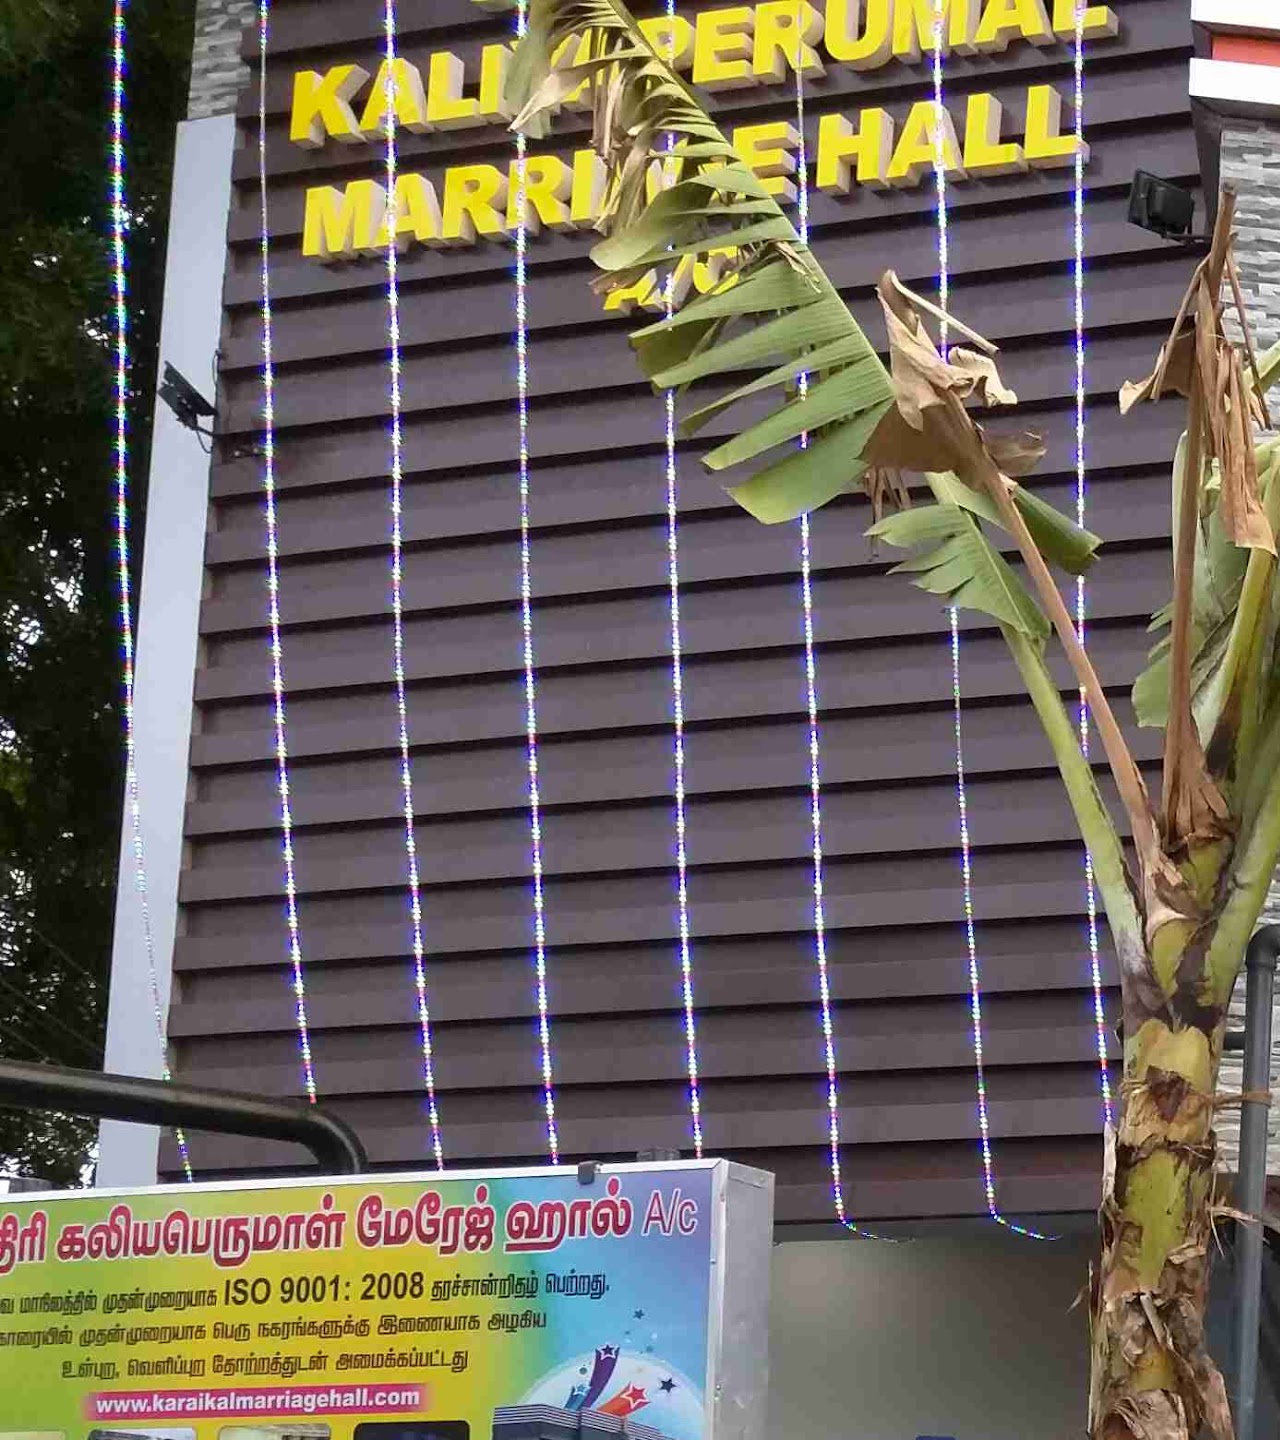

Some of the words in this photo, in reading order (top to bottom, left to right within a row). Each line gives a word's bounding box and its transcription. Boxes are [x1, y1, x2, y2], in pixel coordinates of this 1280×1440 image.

[816, 84, 1088, 192] HALL
[57, 1193, 346, 1268] கலியபெருமாள்
[357, 1184, 494, 1255] மேரேஜ்
[504, 1177, 632, 1252] ஹால்
[643, 1189, 698, 1235] A/c
[224, 1278, 271, 1306] ISO
[280, 1274, 351, 1305] 9001:
[361, 1271, 424, 1300] 2008
[213, 1320, 250, 1341] பெரு
[257, 1314, 370, 1338] நகரங்களுக்கு
[377, 1313, 480, 1335] இணையாக
[487, 1309, 547, 1333] அழகிய
[96, 1388, 420, 1414] www.karaikalmarriagehall.com
